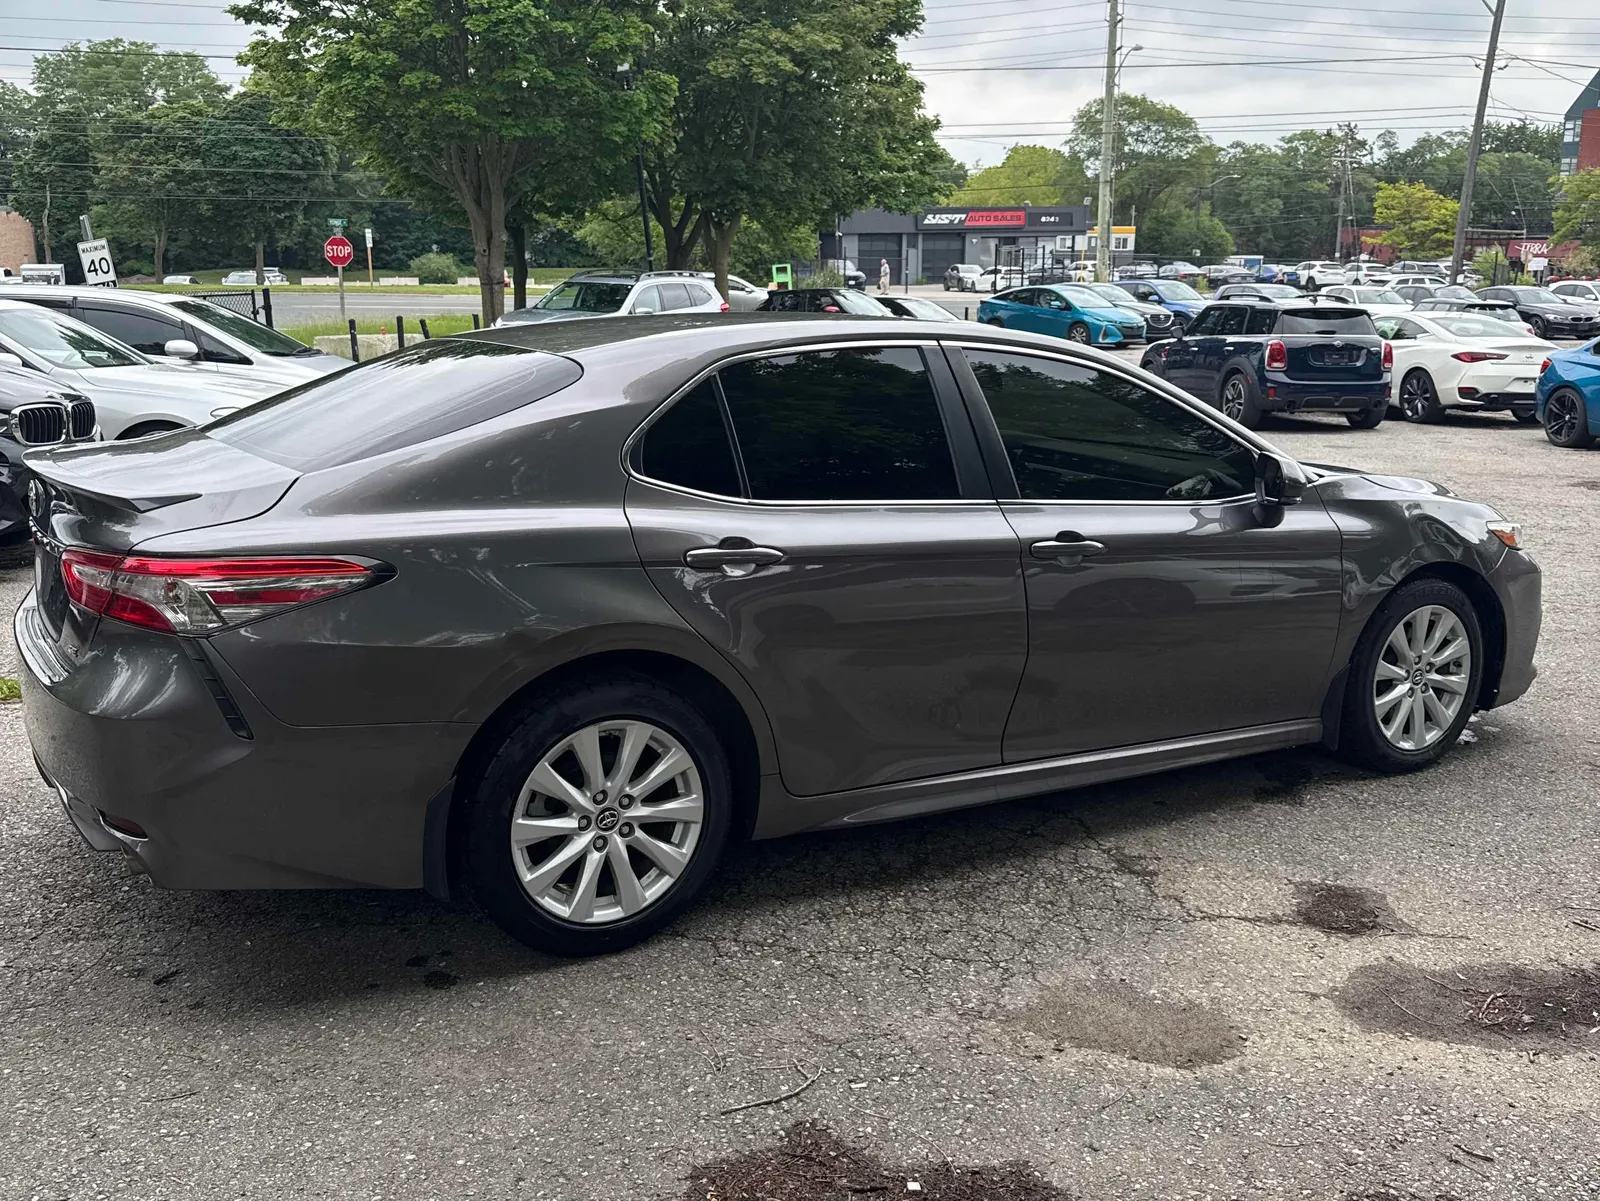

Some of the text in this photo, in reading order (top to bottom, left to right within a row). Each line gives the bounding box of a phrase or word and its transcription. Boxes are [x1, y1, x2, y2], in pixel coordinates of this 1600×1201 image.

[968, 214, 992, 223] AUTO
[993, 214, 1022, 222] SALES
[81, 244, 106, 254] MAXIMUM
[326, 245, 351, 258] STOP
[87, 256, 111, 276] 40
